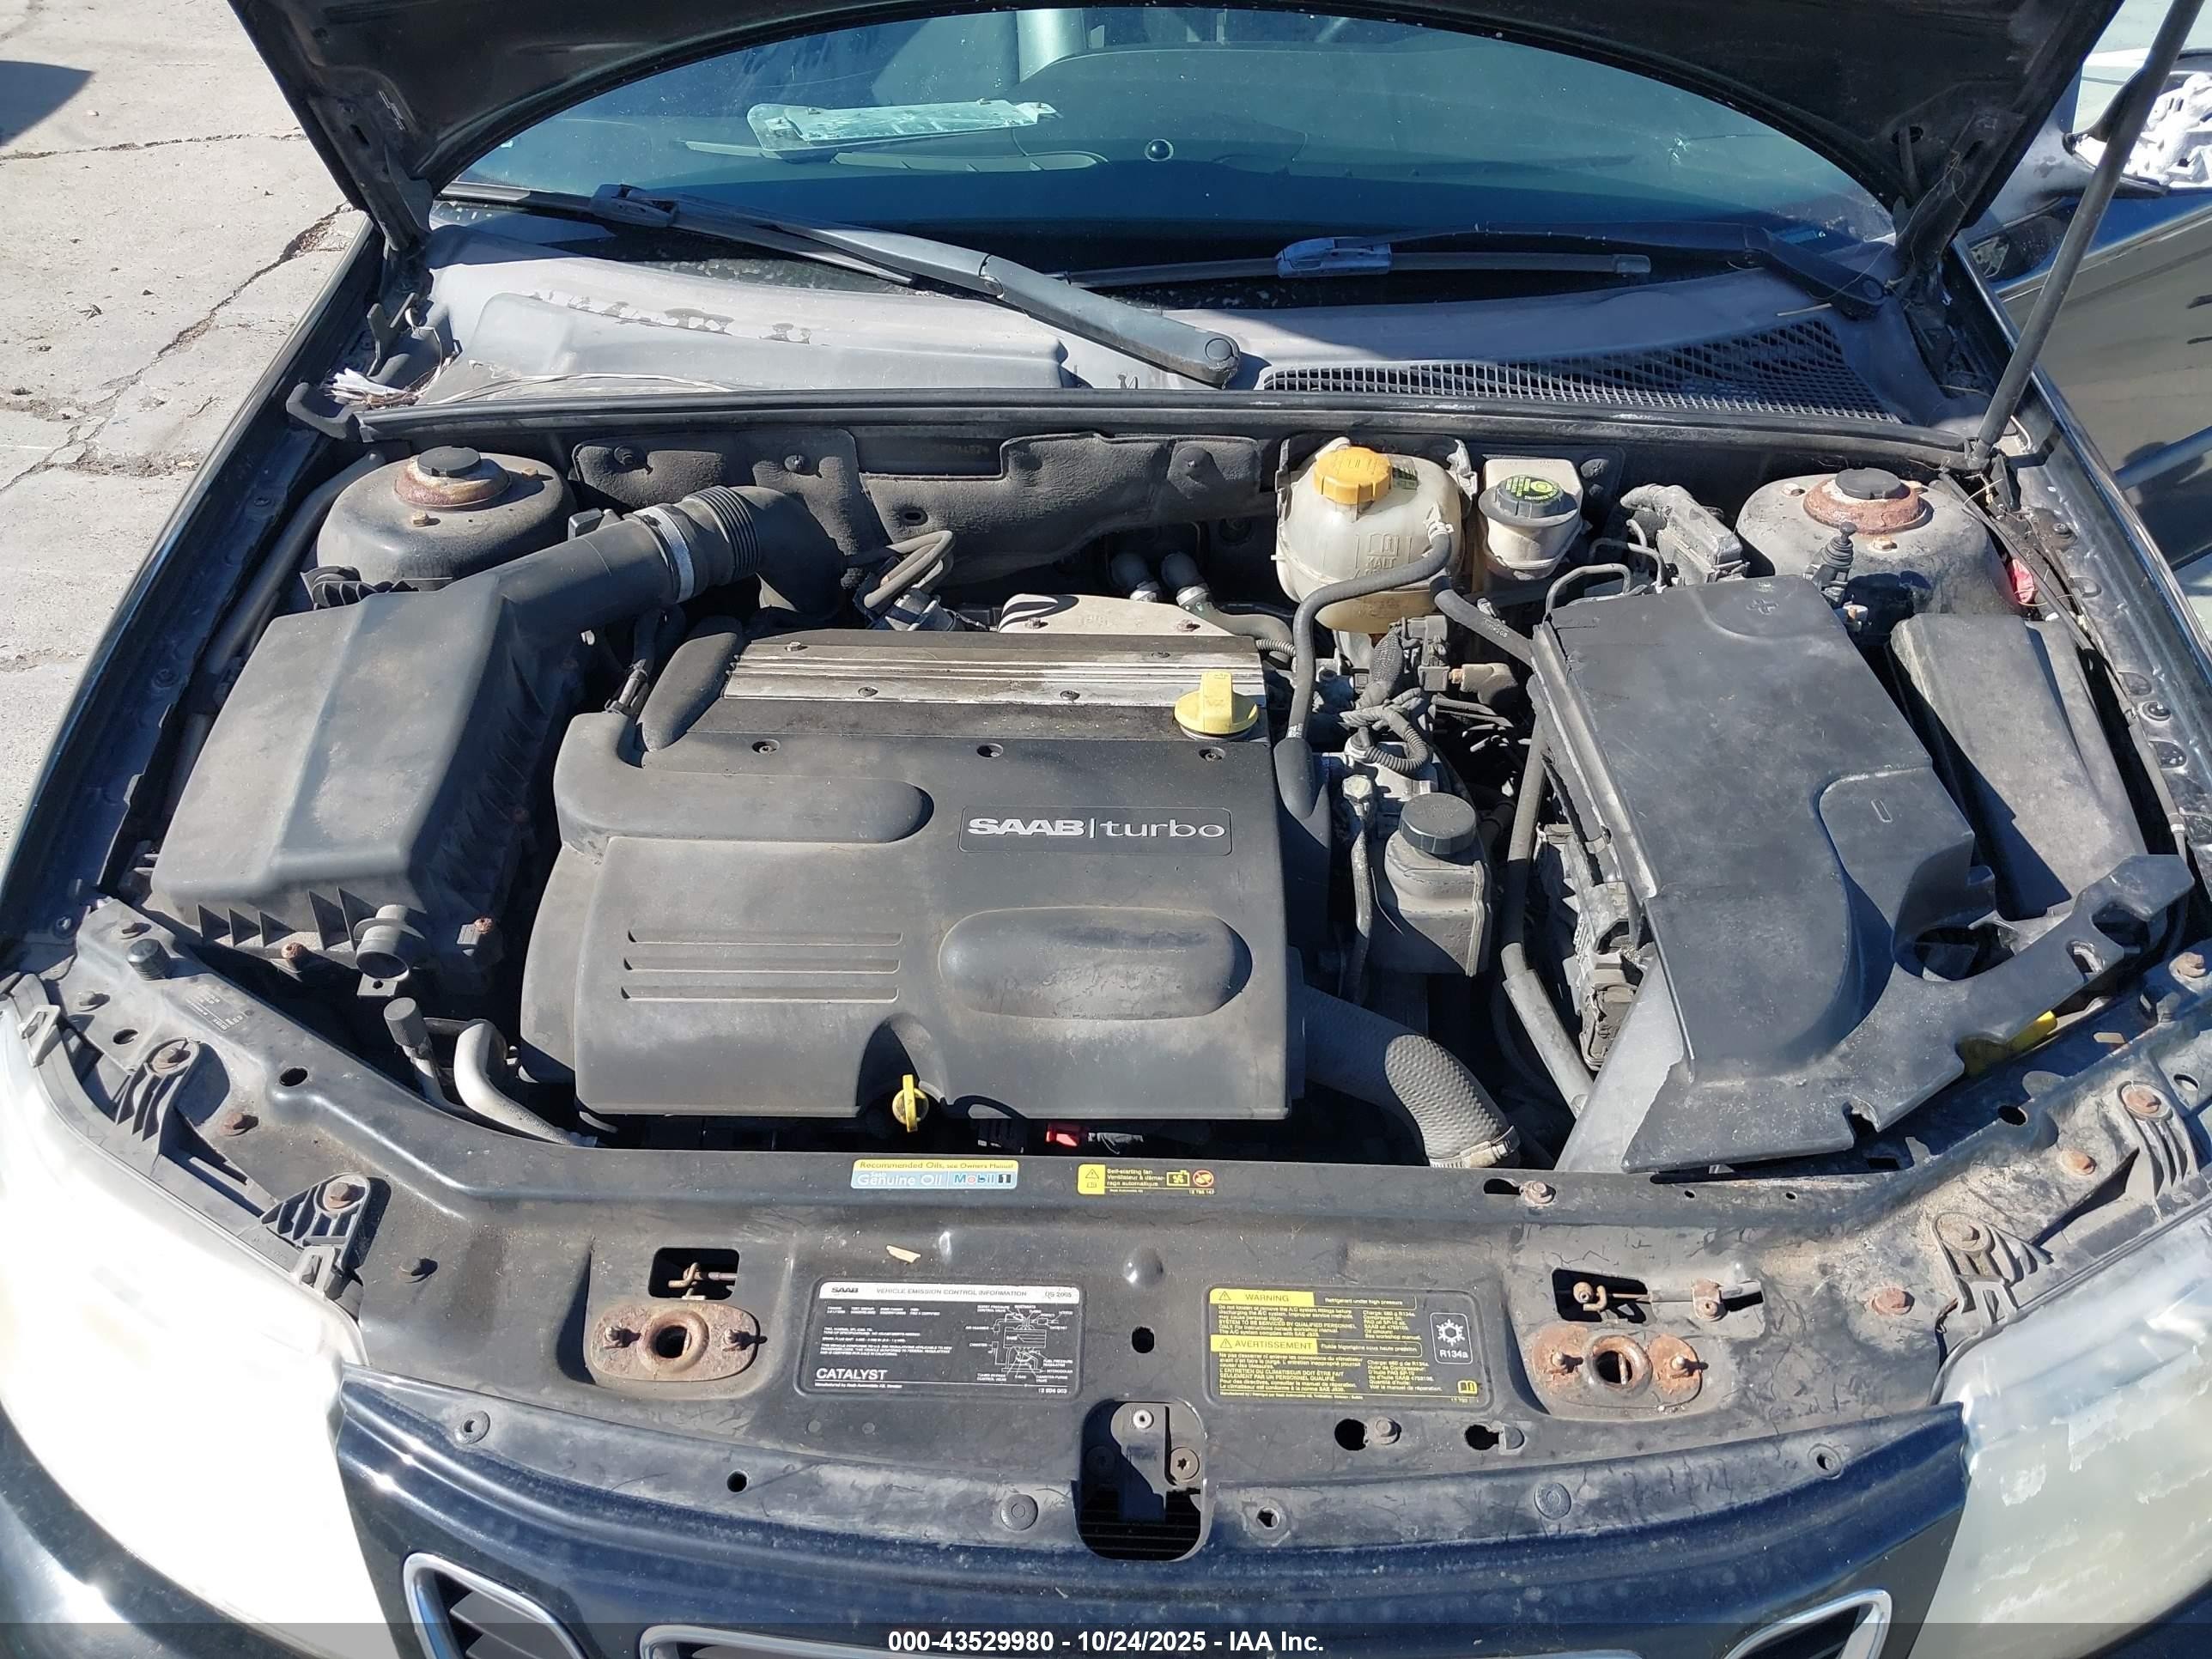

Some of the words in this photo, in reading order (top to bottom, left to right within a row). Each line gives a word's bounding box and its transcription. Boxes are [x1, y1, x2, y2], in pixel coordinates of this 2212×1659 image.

[968, 817, 1086, 836] SAAB
[1099, 819, 1226, 838] turbo
[857, 1172, 915, 1186] Genuine
[920, 1173, 943, 1186] Oil
[954, 1174, 994, 1183] Mobil
[1245, 1293, 1289, 1302] WARNING
[1235, 1341, 1313, 1350] AVERTISSEMENT
[1439, 1349, 1468, 1358] R134a
[816, 1368, 888, 1380] CATALYST
